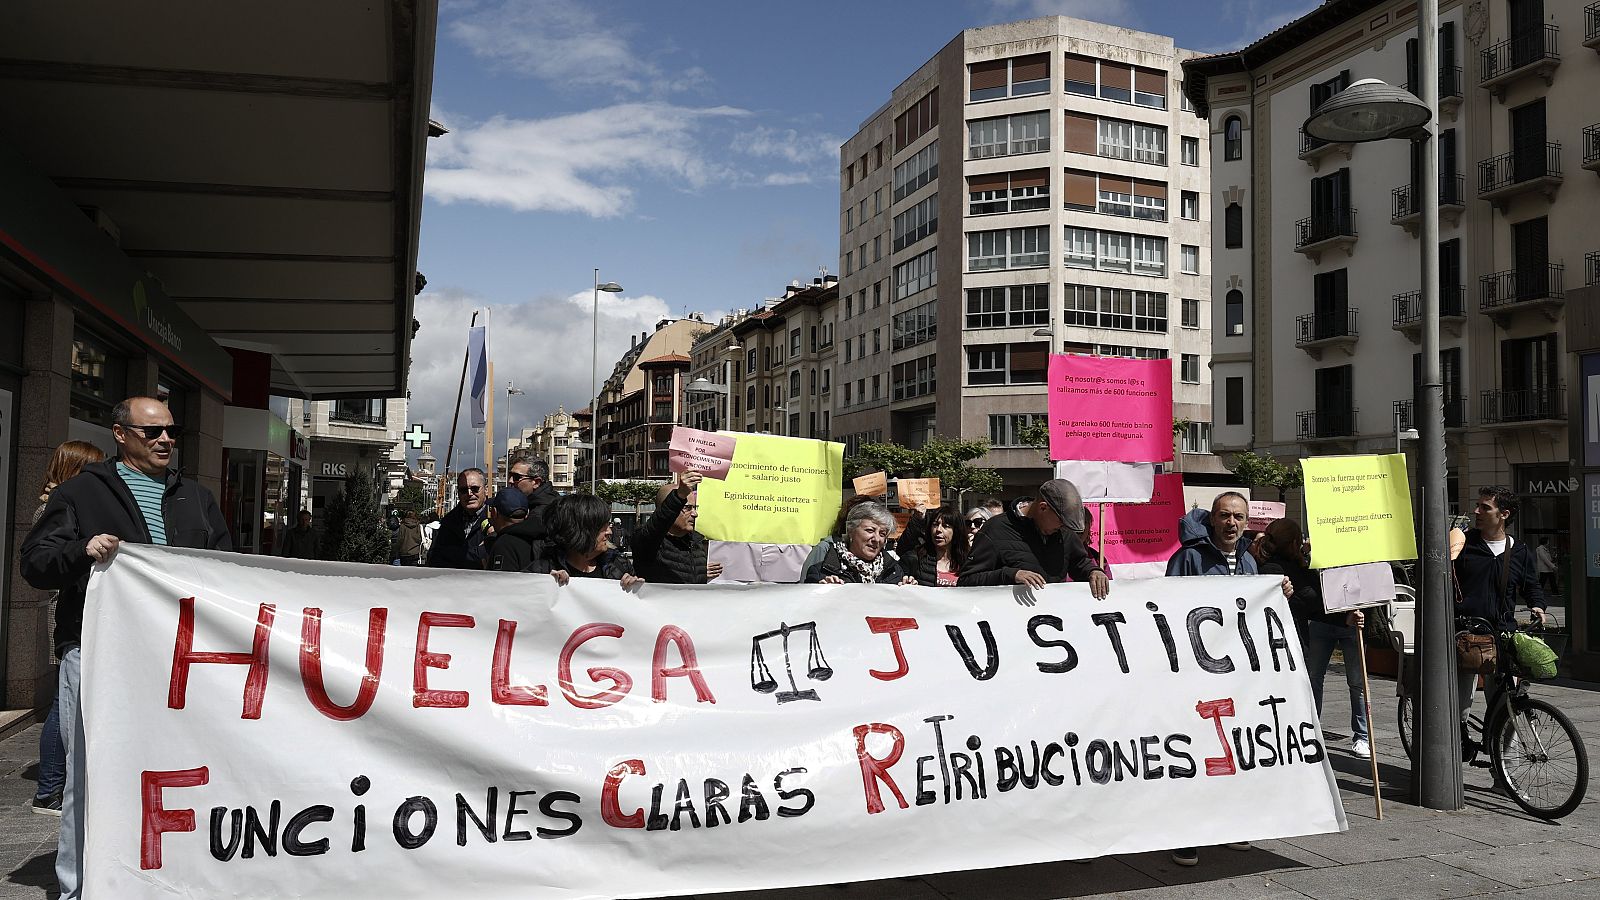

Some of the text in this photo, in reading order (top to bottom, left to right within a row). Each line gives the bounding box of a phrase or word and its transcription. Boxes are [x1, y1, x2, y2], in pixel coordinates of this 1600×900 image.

[1065, 375, 1074, 383] Pq
[1075, 376, 1106, 384] nosotr@s
[1126, 389, 1158, 397] funciones
[1071, 420, 1098, 428] garelako
[1099, 420, 1111, 428] 600
[1092, 431, 1111, 439] egiten
[696, 439, 716, 447] HUELGA
[322, 462, 346, 475] RKS
[779, 464, 790, 472] de
[752, 473, 779, 481] salario
[780, 475, 801, 483] justo
[724, 491, 775, 502] Eginkizunak
[777, 493, 810, 504] aitortzea
[743, 503, 800, 513] soldata justua
[168, 597, 716, 720] HUELGA
[600, 758, 816, 831] CLARAS
[1196, 694, 1326, 777] JUSTAS
